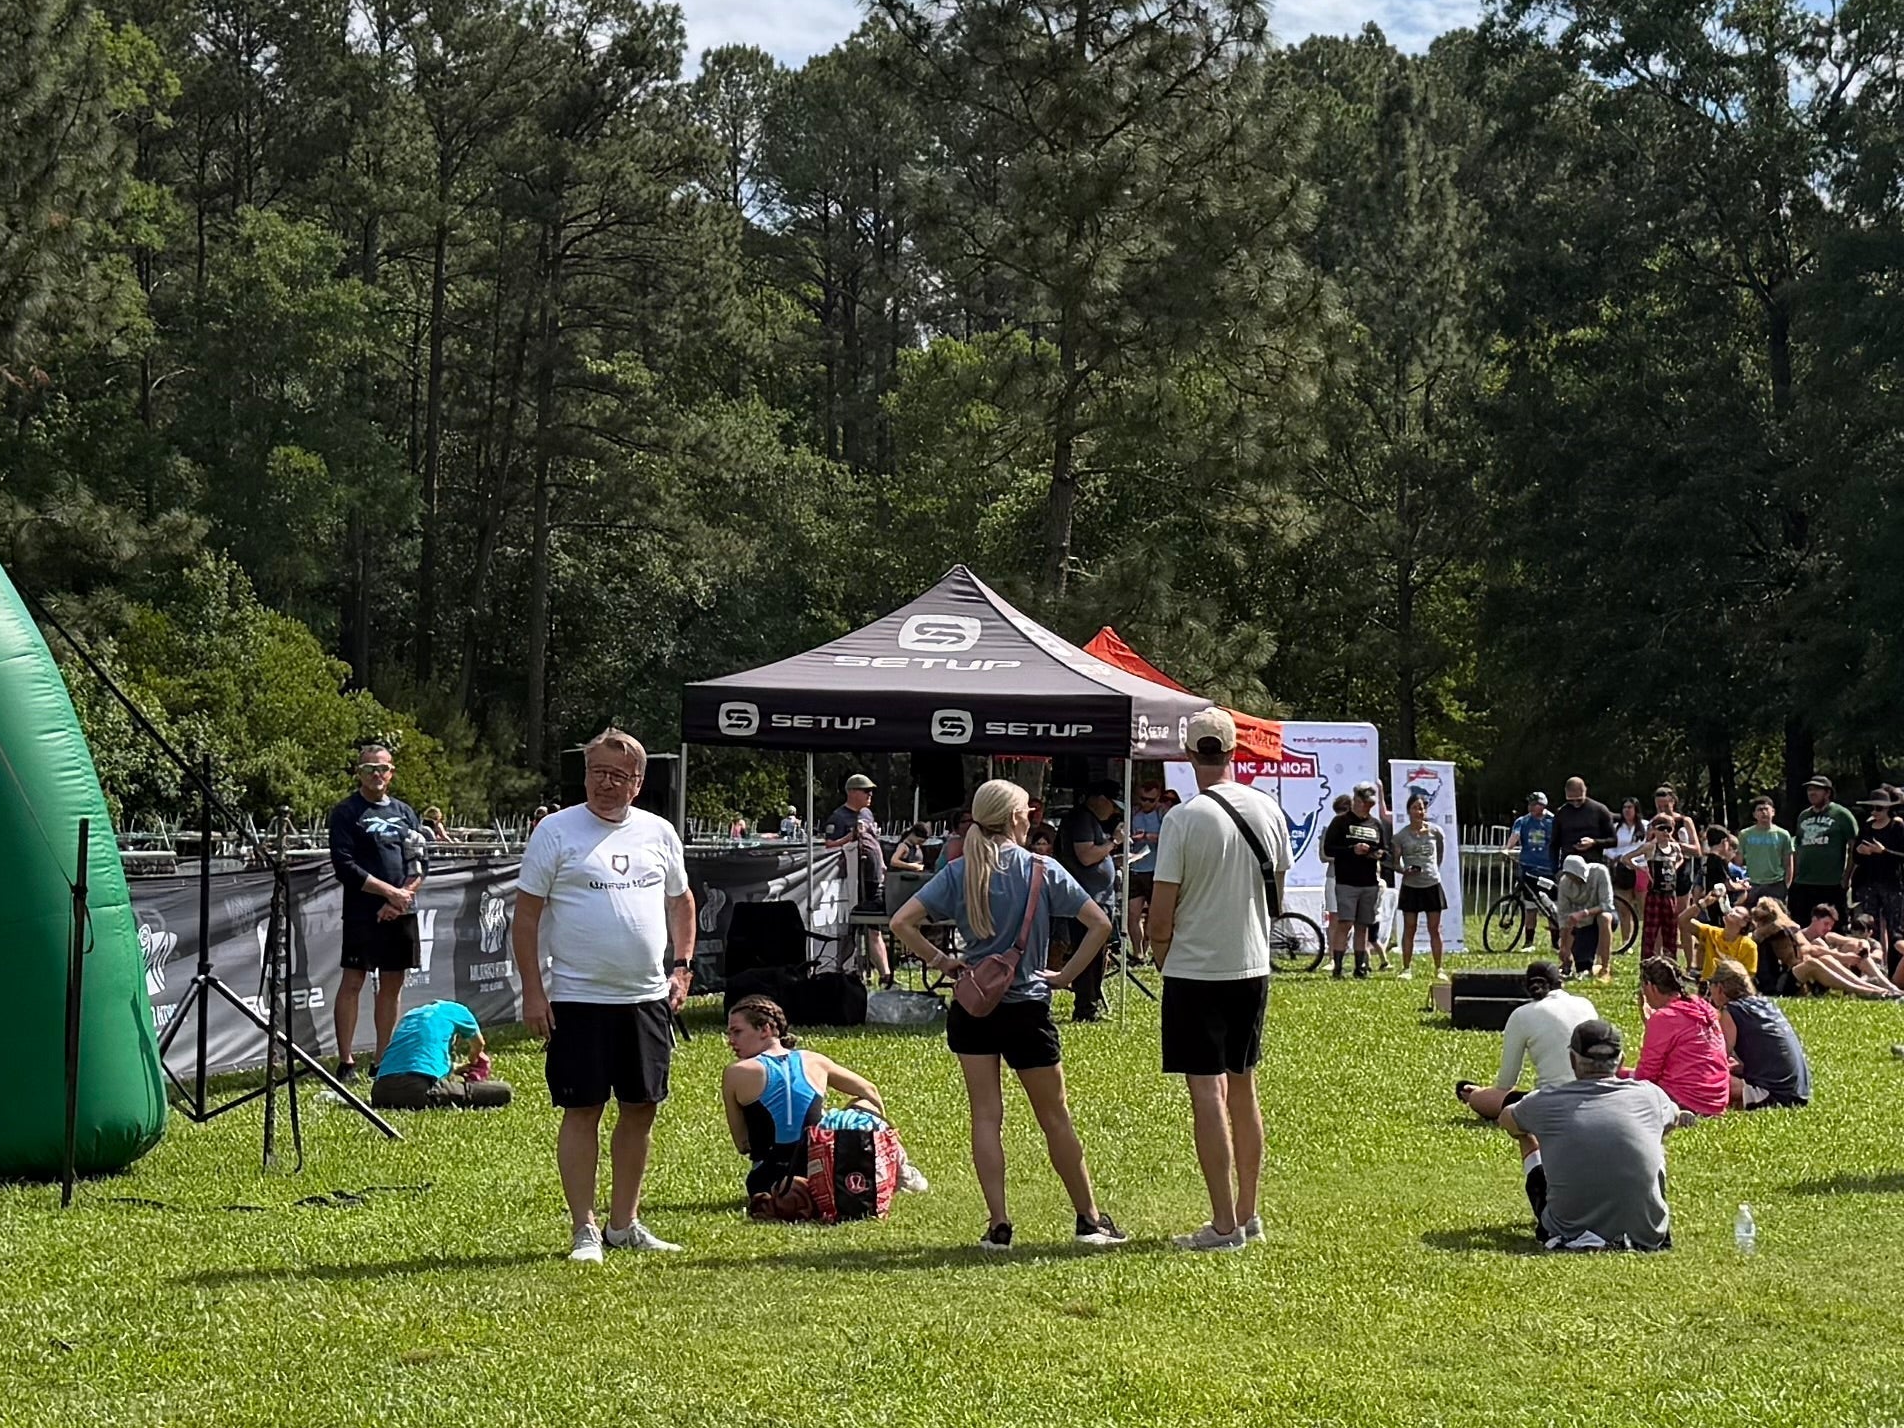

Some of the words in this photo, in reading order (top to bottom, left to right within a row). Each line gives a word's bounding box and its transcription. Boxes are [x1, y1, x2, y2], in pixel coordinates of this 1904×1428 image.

[833, 655, 1022, 671] SETUP
[771, 714, 876, 730] SETUP
[985, 722, 1093, 738] SETUP
[1237, 761, 1257, 774] NC
[1260, 761, 1312, 774] JUNIOR
